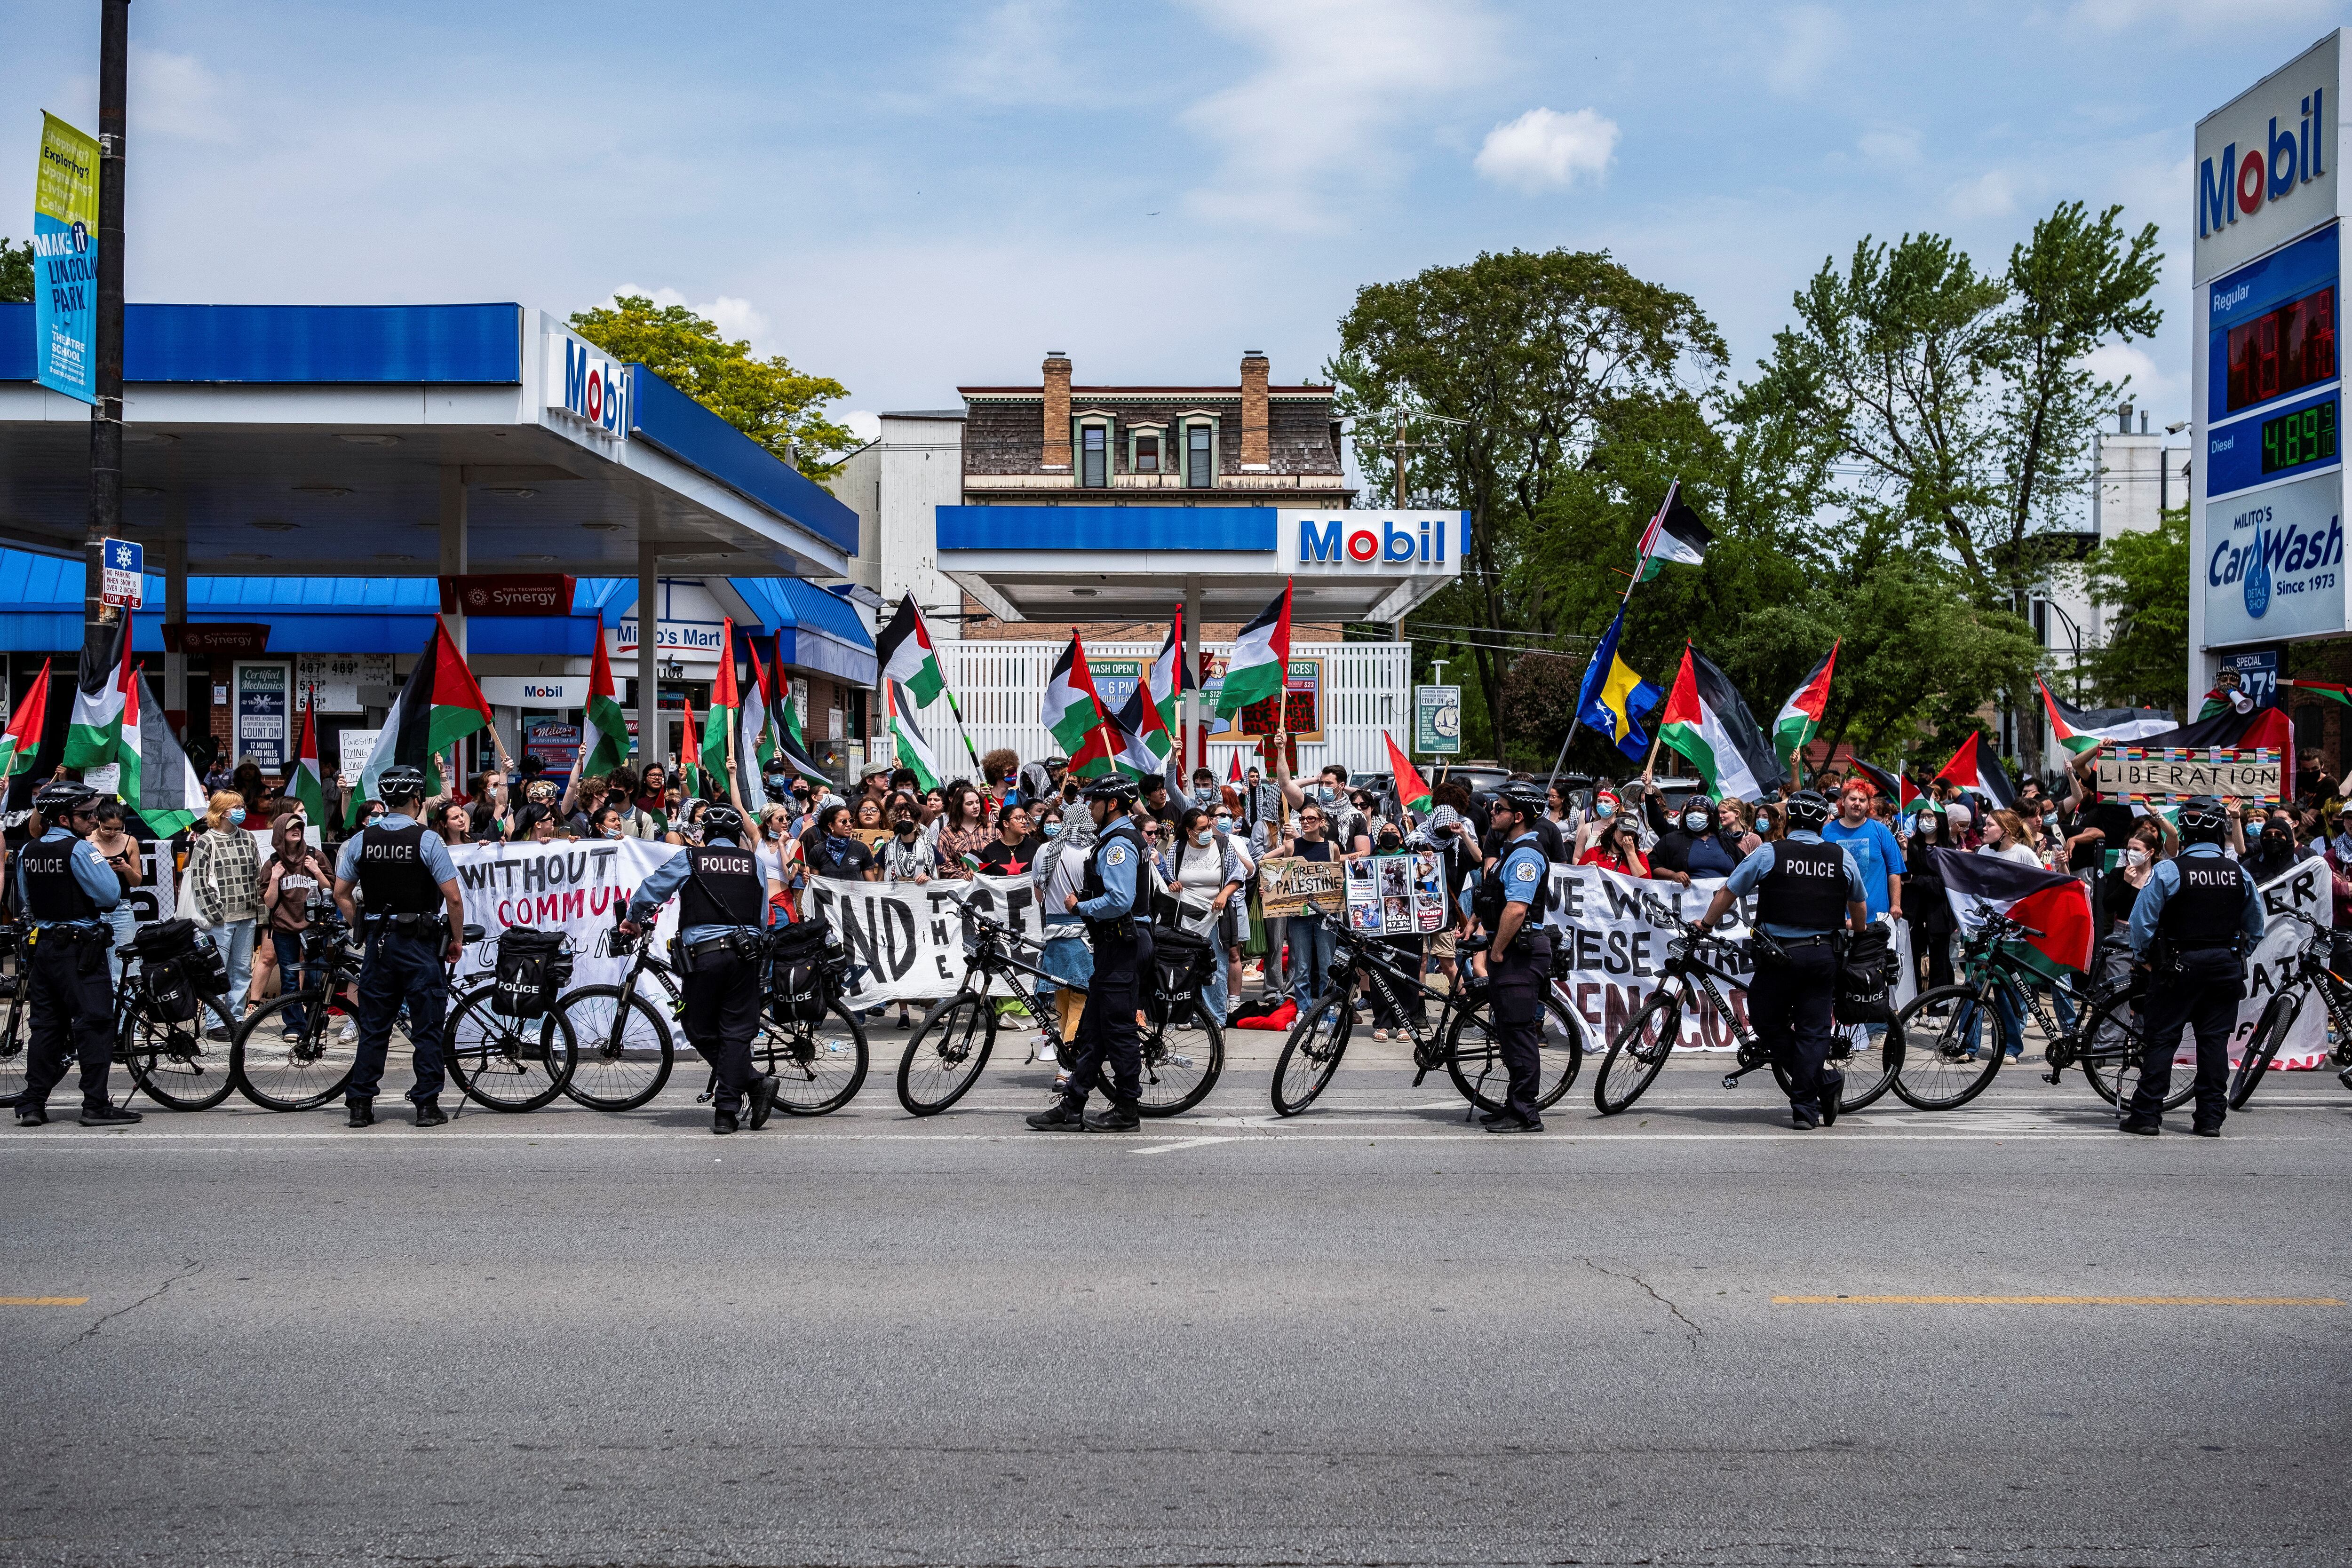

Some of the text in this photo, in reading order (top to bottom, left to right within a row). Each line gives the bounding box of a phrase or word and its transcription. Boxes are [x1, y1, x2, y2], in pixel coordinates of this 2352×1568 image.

[44, 146, 89, 179] Exploring?
[2200, 87, 2323, 239] Mobil
[34, 226, 86, 257] MAKE it
[48, 256, 97, 285] LINCOLN
[52, 285, 87, 314] PARK
[2214, 285, 2249, 312] Regular
[52, 330, 85, 353] THEATRE
[52, 342, 80, 363] SCHOOL
[565, 337, 630, 442] Mobil
[2212, 436, 2234, 454] Diesel
[2265, 409, 2318, 467] 4.89
[2233, 506, 2273, 531] MILITO'S
[1299, 520, 1445, 563] Mobil
[2262, 515, 2343, 574] Wash
[115, 570, 131, 579] PARKING
[2255, 577, 2259, 586] &
[450, 583, 453, 594] 1
[2276, 573, 2335, 596] Since 1973
[106, 594, 120, 604] TOW
[493, 590, 556, 605] Synergy
[2248, 589, 2266, 599] DETAIL
[2249, 598, 2265, 610] SHOP
[204, 635, 252, 646] Synergy
[683, 629, 720, 647] Mart
[1089, 664, 1134, 673] WASH OPEN!
[2237, 655, 2262, 667] SPECIAL
[245, 669, 280, 682] Certified
[241, 680, 284, 690] Mechanics
[524, 686, 563, 697] Mobil
[1108, 681, 1134, 694] 6 PM
[242, 728, 281, 738] COUNT ON!
[536, 725, 572, 737] Milito's
[344, 761, 364, 770] LYING
[2100, 765, 2276, 786] LIBERATION
[366, 845, 413, 860] POLICE
[1108, 847, 1123, 857] CHICAGO
[25, 858, 64, 873] POLICE
[457, 847, 617, 893] WITHOUT
[701, 857, 749, 873] POLICE
[1293, 865, 1324, 876] FREE
[1518, 863, 1534, 872] CHICAGO
[1787, 859, 1835, 878] POLICE
[1276, 876, 1343, 894] PALESTINE
[2189, 871, 2237, 887] POLICE
[498, 981, 539, 994] POLICE
[656, 972, 680, 1001] CHICAG
[773, 990, 812, 1003] POLICE
[1155, 989, 1191, 1001] POLICE
[1370, 968, 1413, 1033] CHICAGO POLICE
[1845, 990, 1886, 1003] POLICE
[2314, 973, 2336, 1006] CHICAGO
[2332, 1006, 2352, 1033] POLICE
[1009, 979, 1054, 1035] CHICAGO POLIC
[1702, 978, 1743, 1037] CHICAGO POLICE
[2016, 981, 2058, 1042] CHICAGO POLICE
[295, 1096, 327, 1109] BONTRAGER
